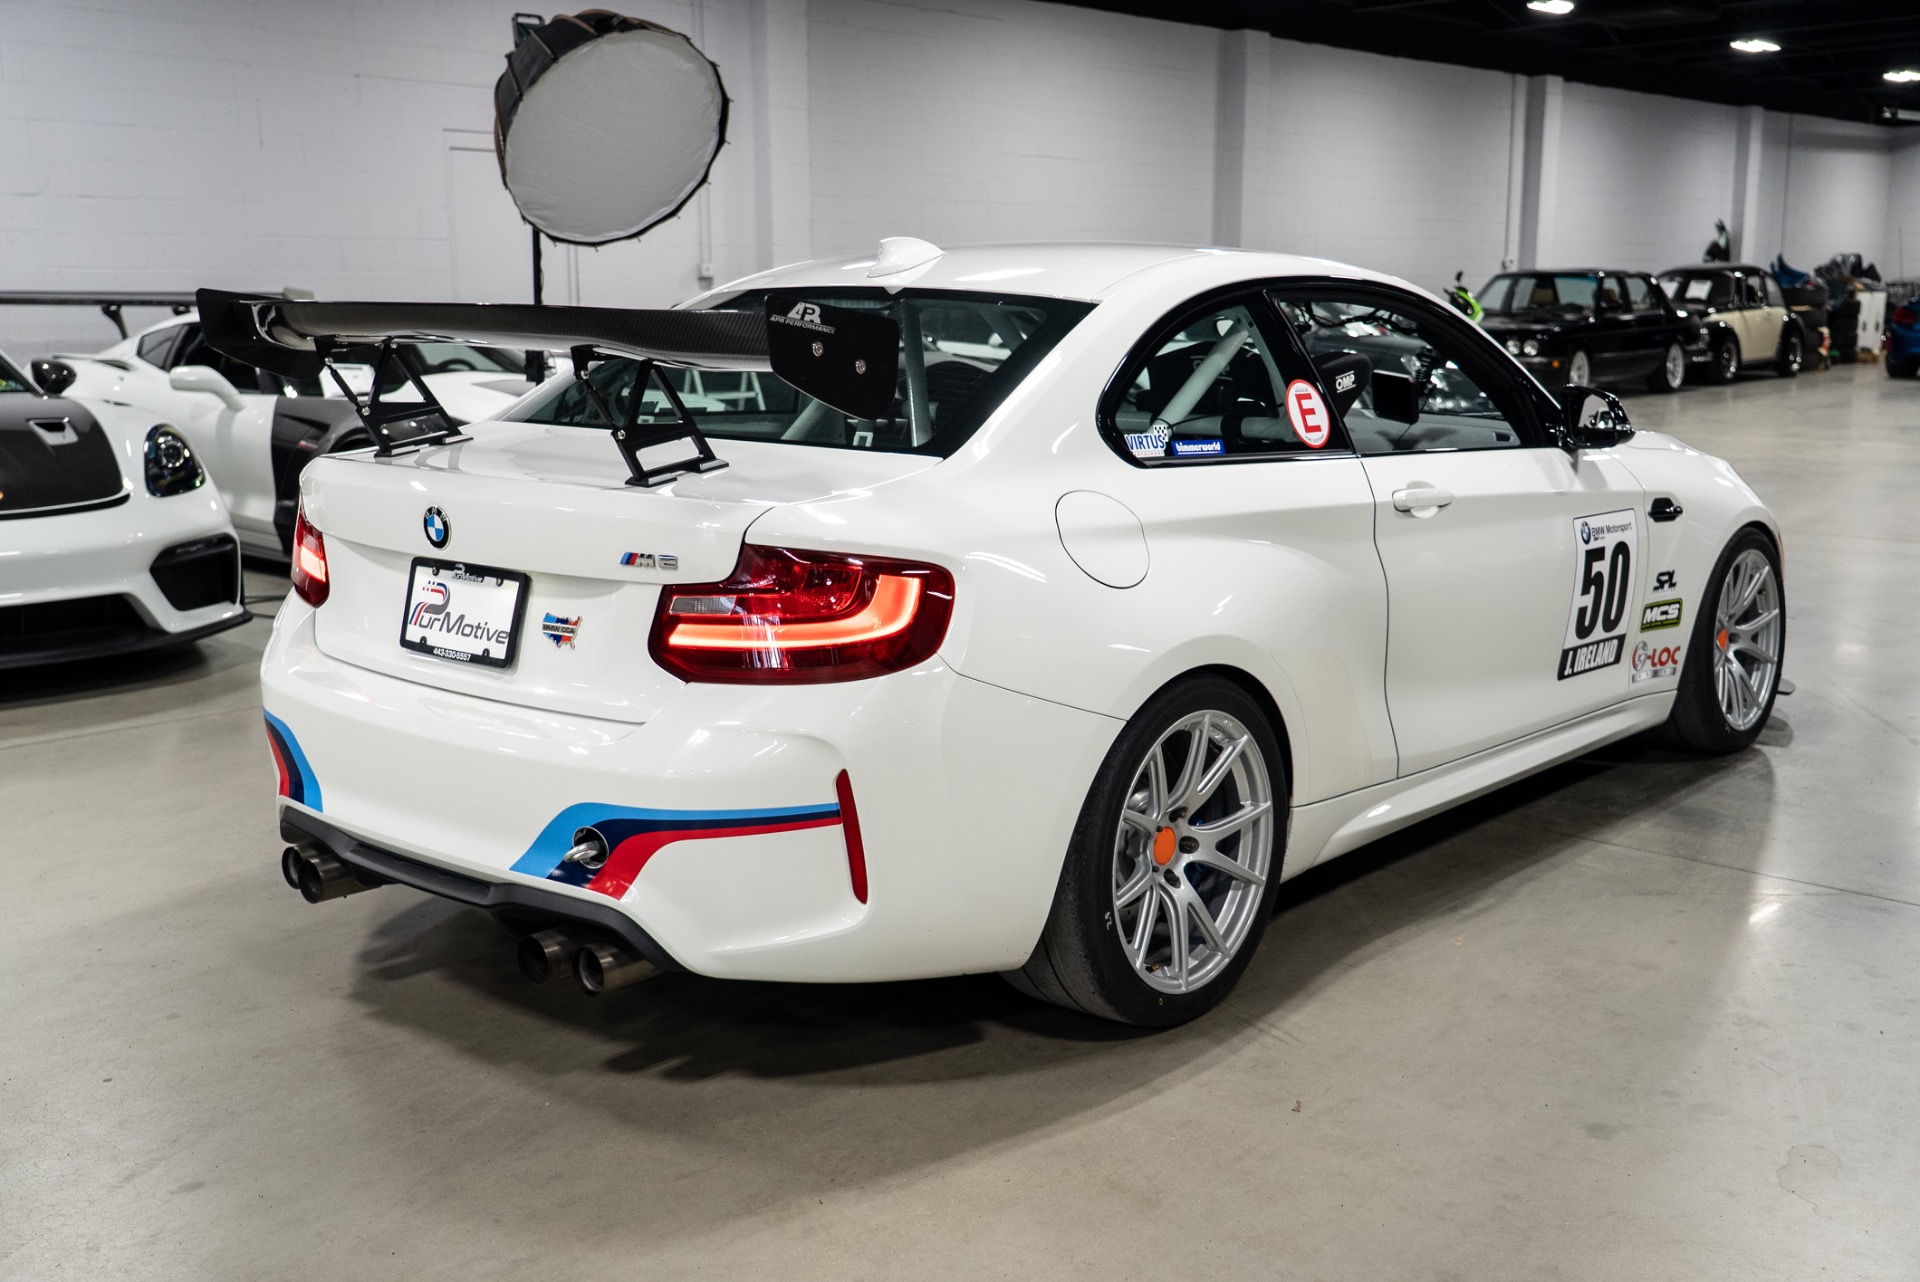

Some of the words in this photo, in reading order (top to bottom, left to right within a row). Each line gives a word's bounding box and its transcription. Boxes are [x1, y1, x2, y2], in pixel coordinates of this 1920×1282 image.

[785, 319, 836, 334] PERFORMANCE
[1336, 373, 1355, 390] OMP
[1294, 393, 1322, 433] E
[1125, 434, 1165, 451] VIRTUS
[1175, 441, 1221, 452] bimmerworld
[1591, 526, 1605, 537] BMW
[1605, 521, 1633, 534] Motorsport
[1653, 569, 1677, 591] SPL
[1575, 541, 1631, 640] 50
[1642, 603, 1680, 625] MCS
[542, 624, 560, 633] BMW
[561, 626, 575, 635] CCA
[433, 646, 471, 662] 443-330-5557
[1564, 650, 1573, 675] J.
[1573, 639, 1619, 673] IRELAND
[1632, 640, 1681, 671] G-LOC
